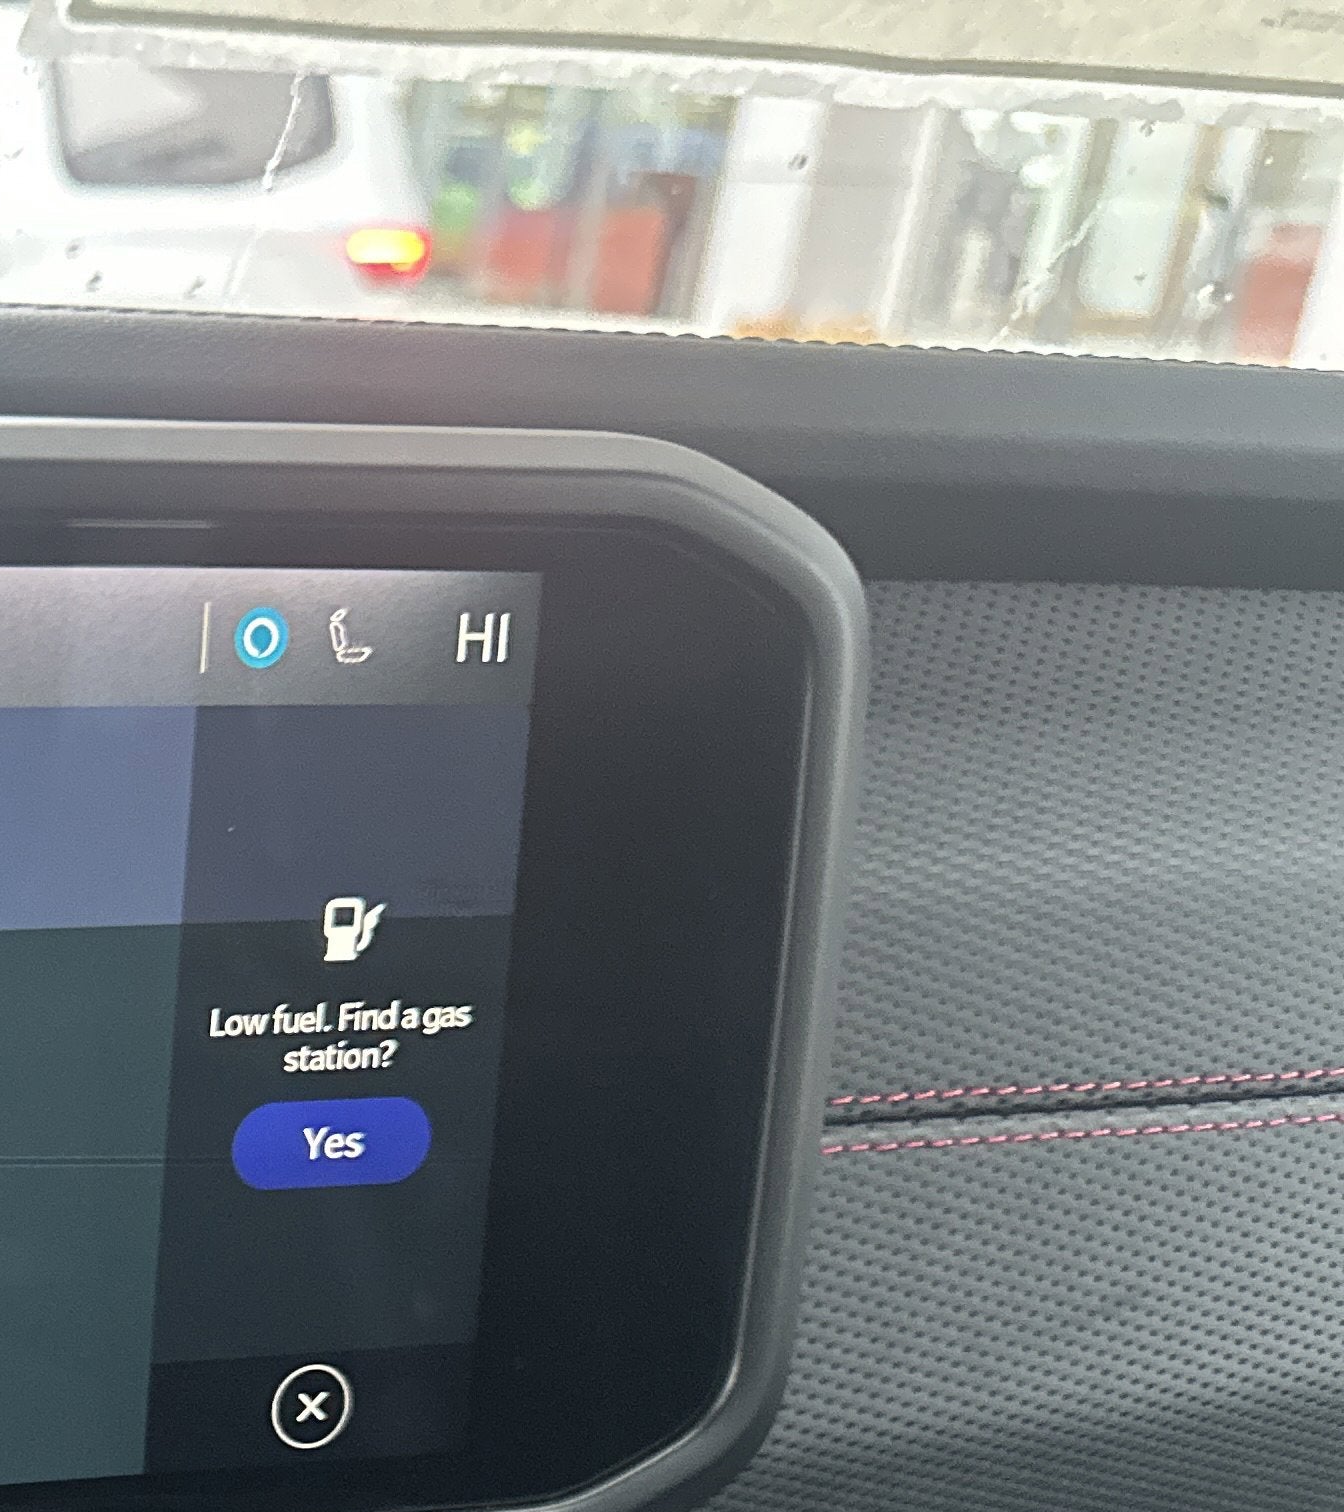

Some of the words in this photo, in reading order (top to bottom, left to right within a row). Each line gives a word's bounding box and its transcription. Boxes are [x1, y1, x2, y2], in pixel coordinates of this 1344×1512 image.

[457, 613, 510, 662] HI
[210, 1008, 266, 1037] Low
[272, 1003, 332, 1034] fuel.
[338, 1000, 398, 1031] Find
[401, 1008, 418, 1029] a
[423, 1006, 472, 1034] gas
[284, 1040, 397, 1072] station?
[303, 1127, 364, 1159] Yes
